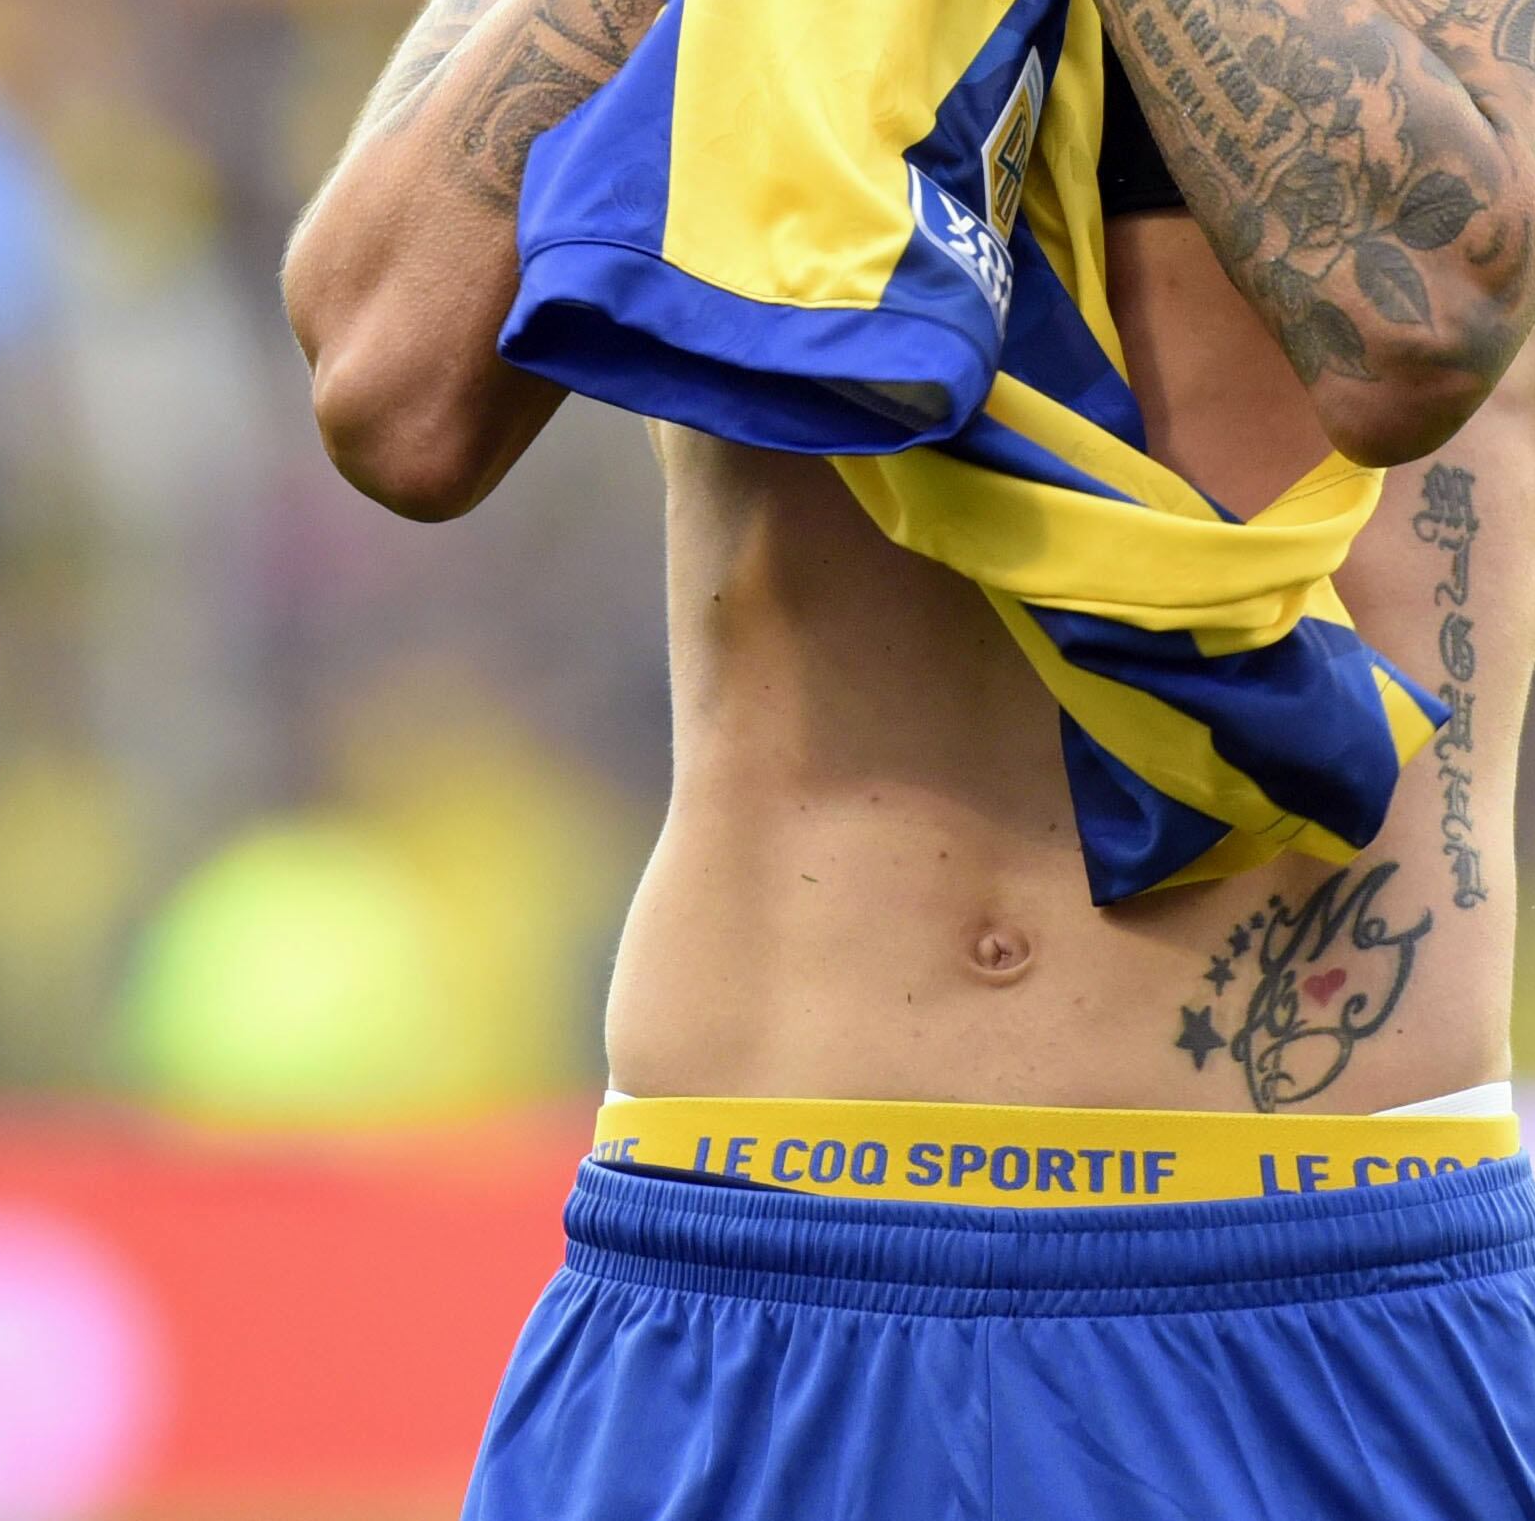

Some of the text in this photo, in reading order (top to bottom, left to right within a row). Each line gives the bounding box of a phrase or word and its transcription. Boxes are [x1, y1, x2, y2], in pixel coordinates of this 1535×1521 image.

[692, 1136, 1177, 1195] LE COQ SPORTIF
[1258, 1154, 1330, 1196] LE
